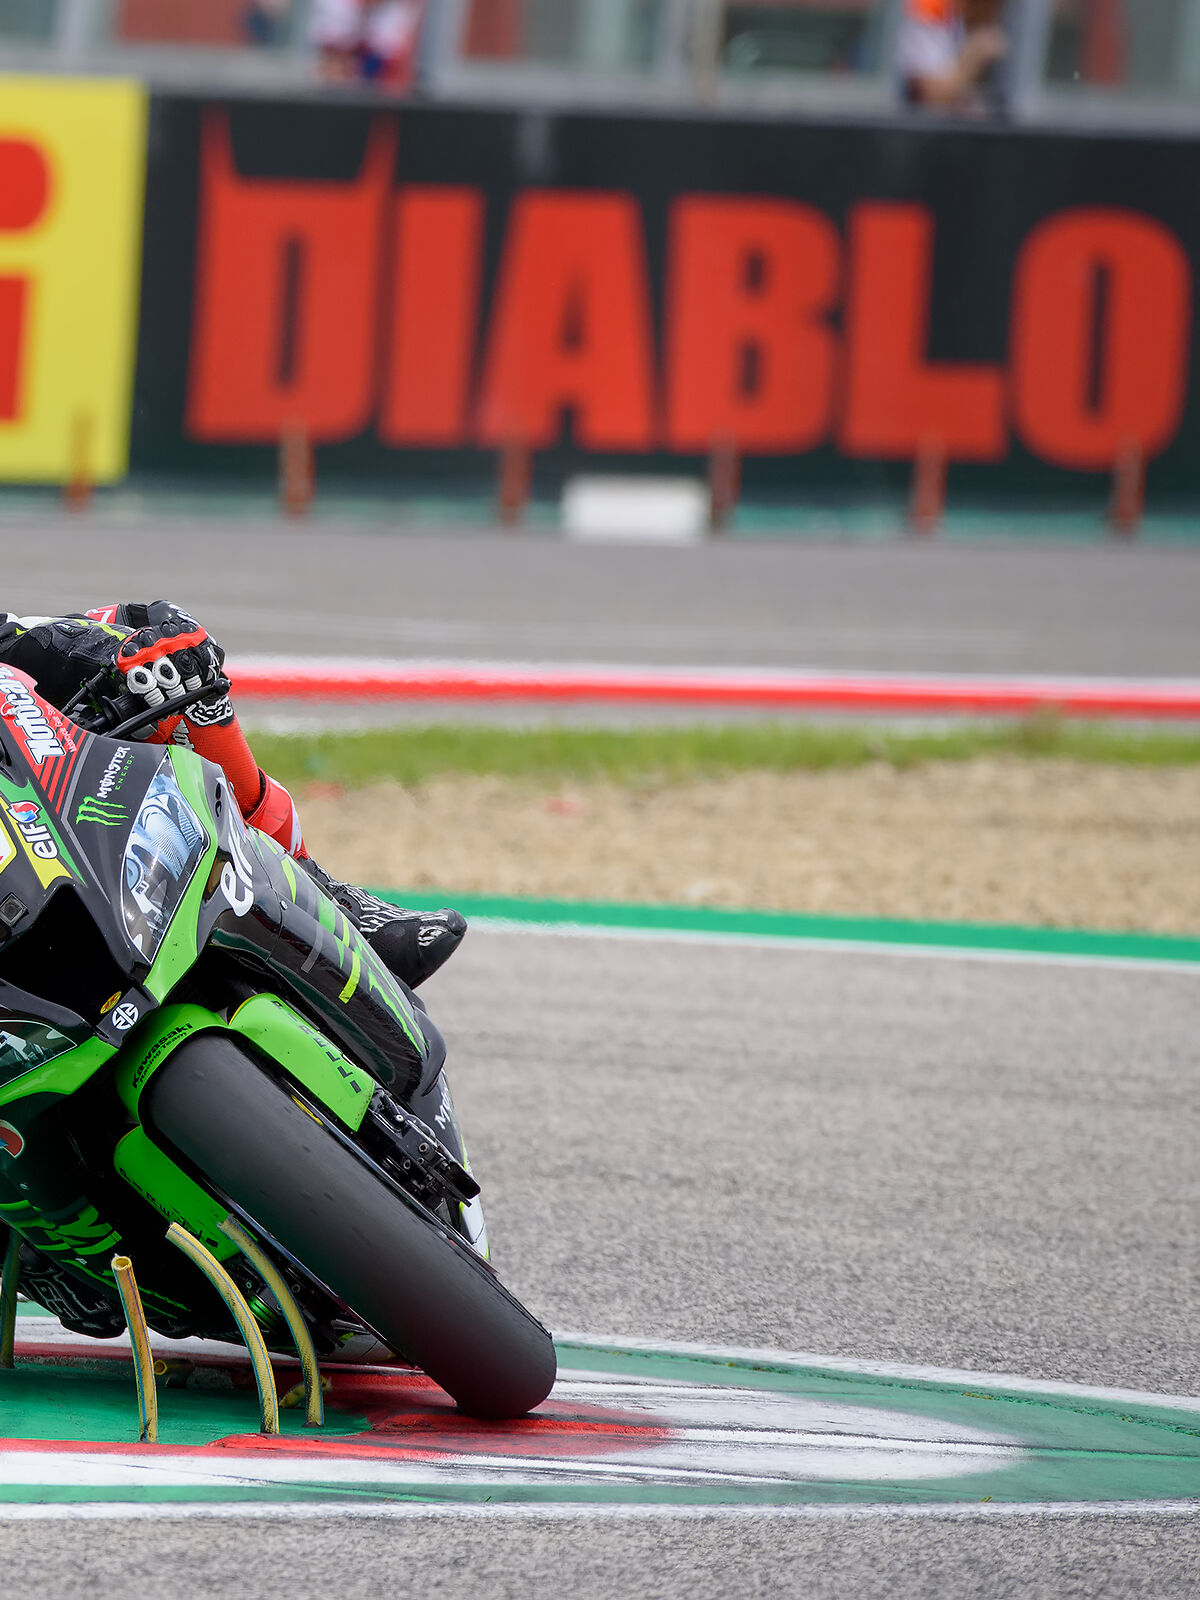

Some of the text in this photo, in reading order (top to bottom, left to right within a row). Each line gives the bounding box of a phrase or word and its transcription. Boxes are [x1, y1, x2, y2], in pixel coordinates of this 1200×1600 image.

[185, 106, 1193, 471] DIABLO
[115, 754, 135, 791] ENERGY
[17, 822, 59, 859] elf
[132, 1022, 193, 1089] Kawasaki
